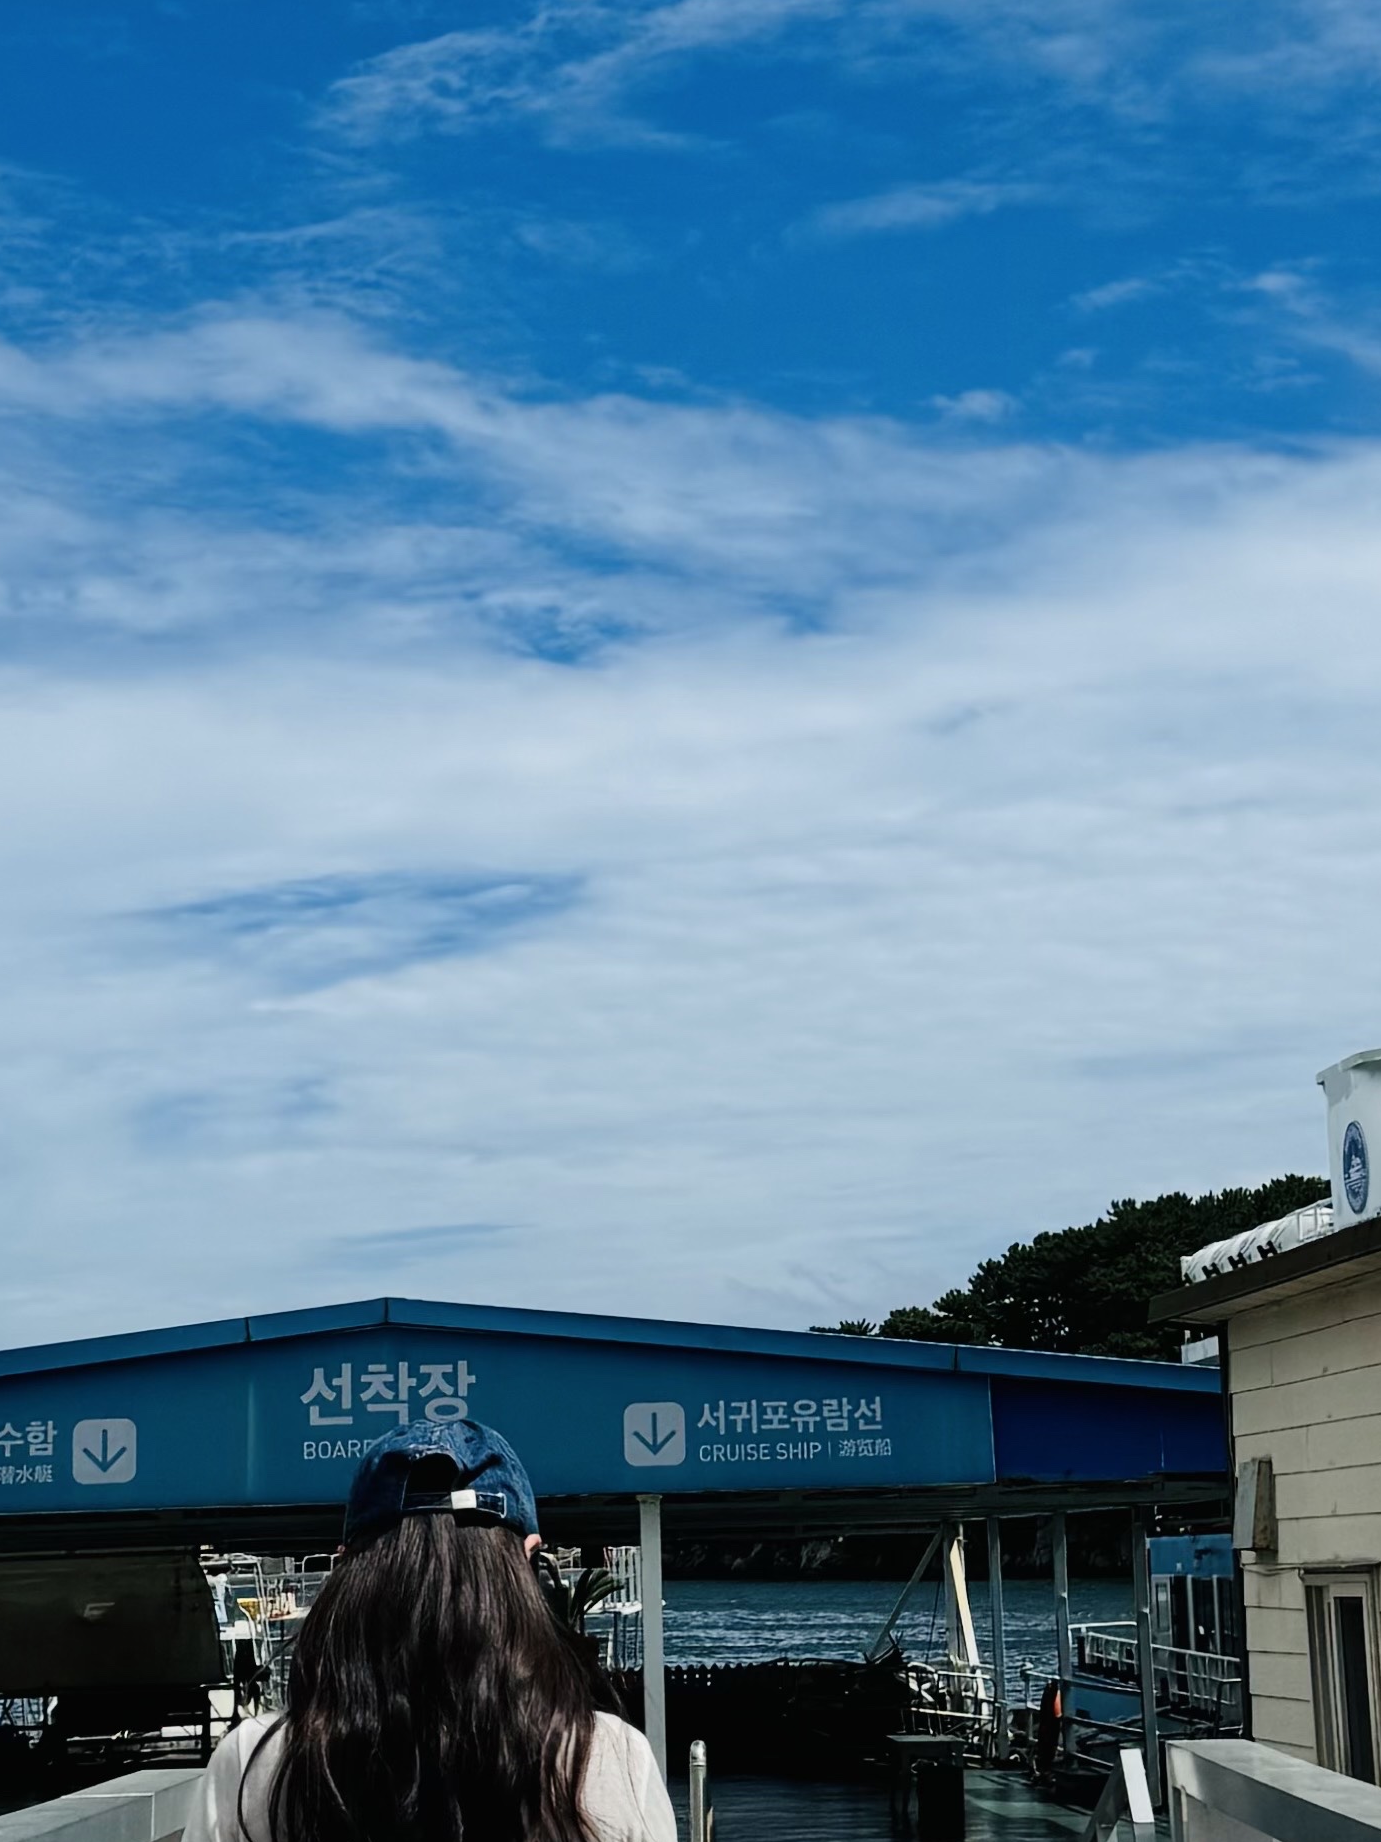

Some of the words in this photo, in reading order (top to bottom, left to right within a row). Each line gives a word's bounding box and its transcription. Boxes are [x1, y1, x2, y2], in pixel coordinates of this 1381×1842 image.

[300, 1360, 476, 1425] 선착장
[697, 1396, 883, 1435] 서귀포유람선
[699, 1443, 771, 1462] CRUISE
[776, 1441, 822, 1460] SHIP
[838, 1438, 892, 1457] 游览船
